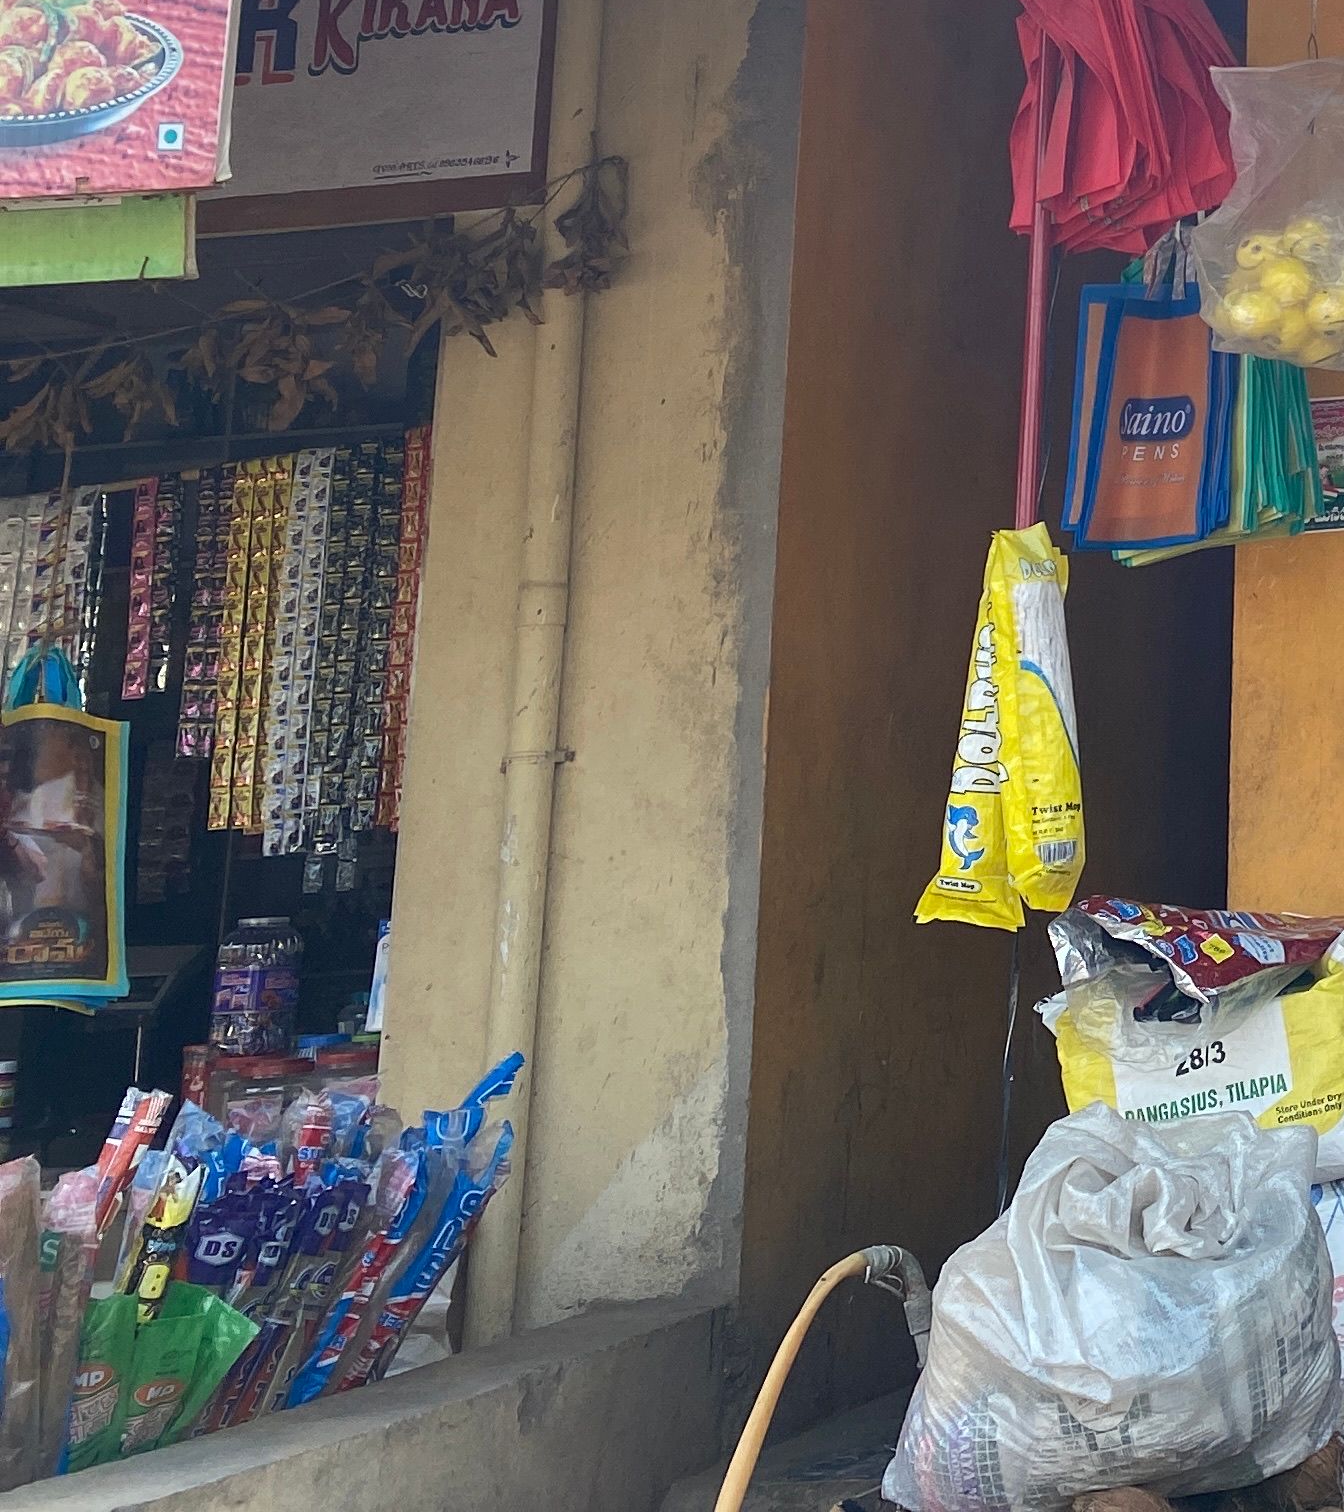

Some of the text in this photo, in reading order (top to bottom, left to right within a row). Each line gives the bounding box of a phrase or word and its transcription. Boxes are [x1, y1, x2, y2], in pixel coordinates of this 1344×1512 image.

[1120, 401, 1187, 436] Saino
[1121, 442, 1180, 463] PENS
[1031, 801, 1063, 816] Twist
[1175, 1040, 1227, 1078] 28/3
[1225, 1072, 1289, 1105] TILAPIA
[1275, 1092, 1343, 1116] Store Under Dry
[1277, 1100, 1343, 1124] Conditions Only
[203, 1240, 237, 1258] DS
